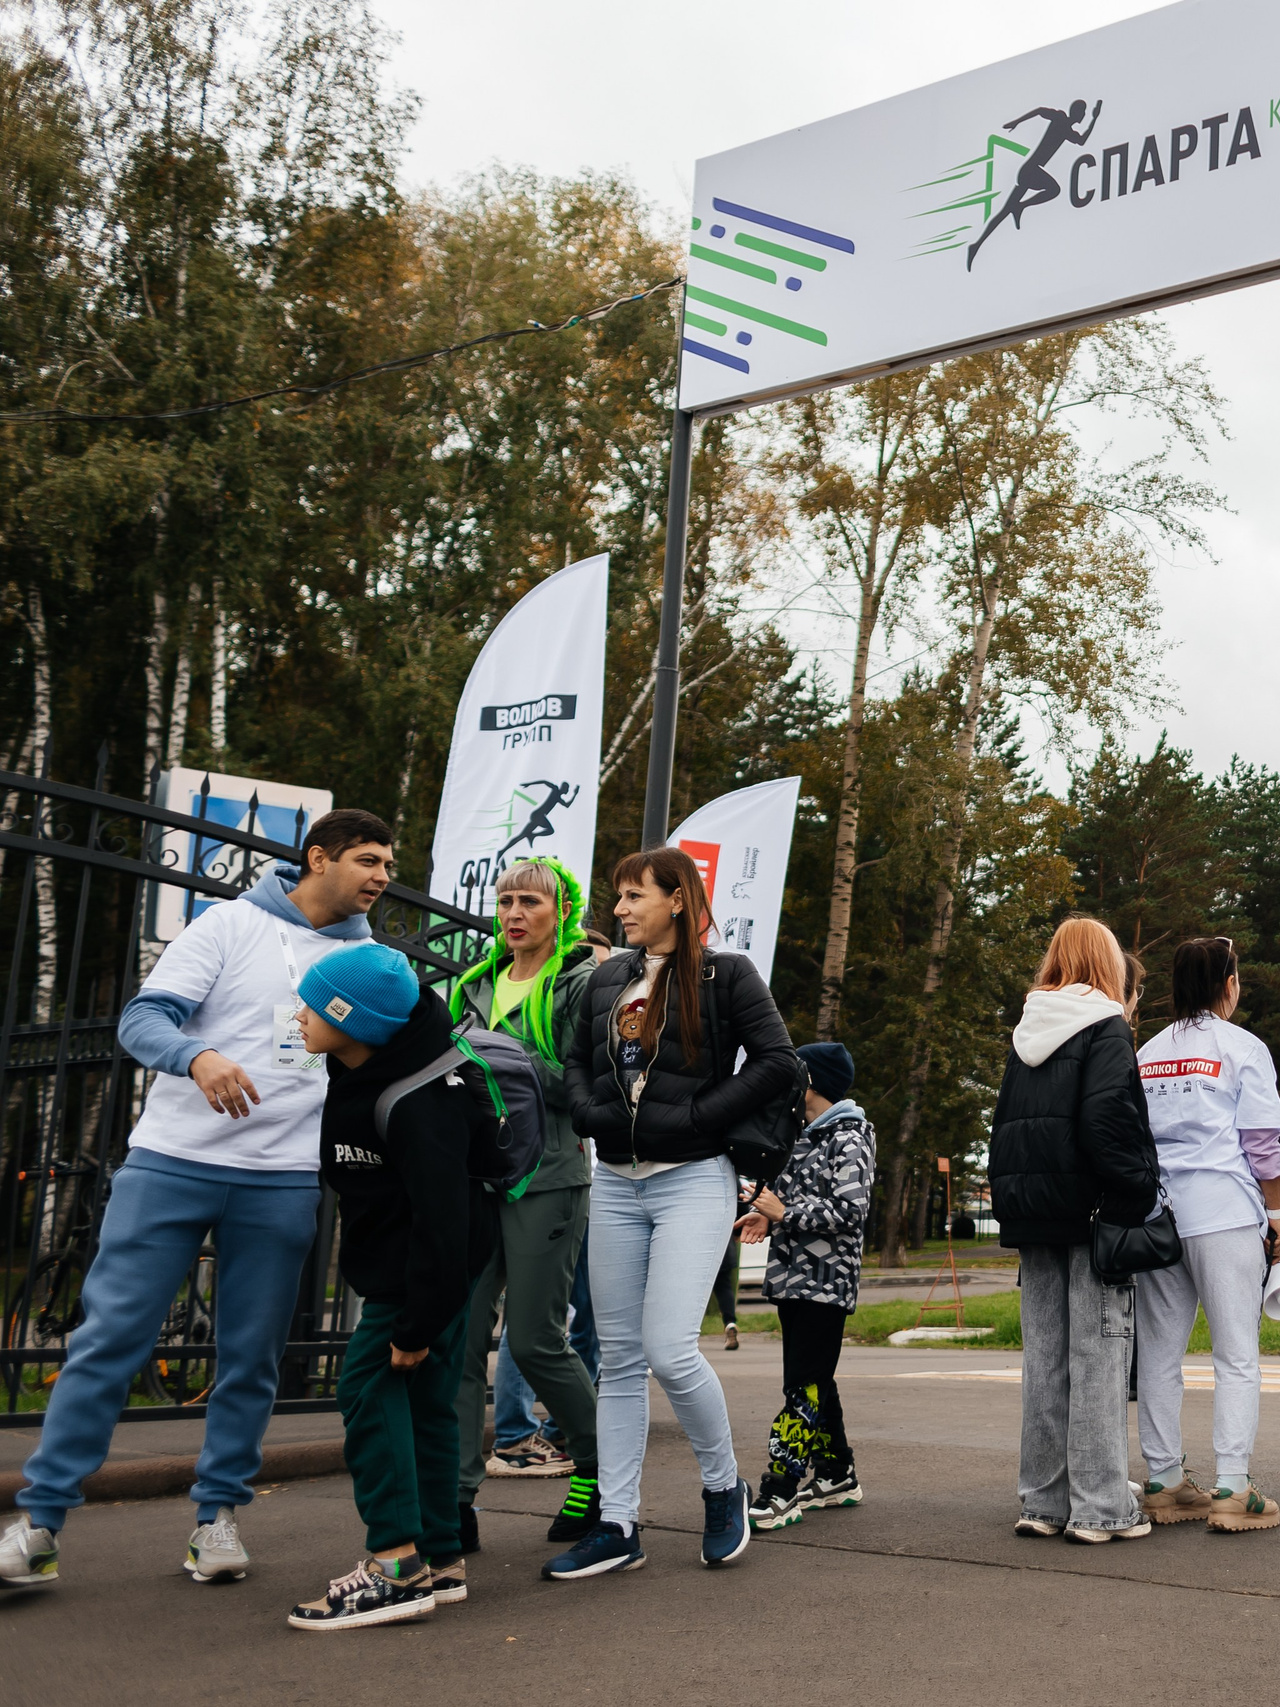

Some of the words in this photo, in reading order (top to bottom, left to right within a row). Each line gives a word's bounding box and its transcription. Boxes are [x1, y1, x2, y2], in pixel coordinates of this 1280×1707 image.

[1069, 105, 1262, 209] СПАРТА
[1140, 1063, 1178, 1077] ВОЛКОВ
[1180, 1060, 1215, 1074] ГРУПП
[334, 1143, 383, 1165] PARIS
